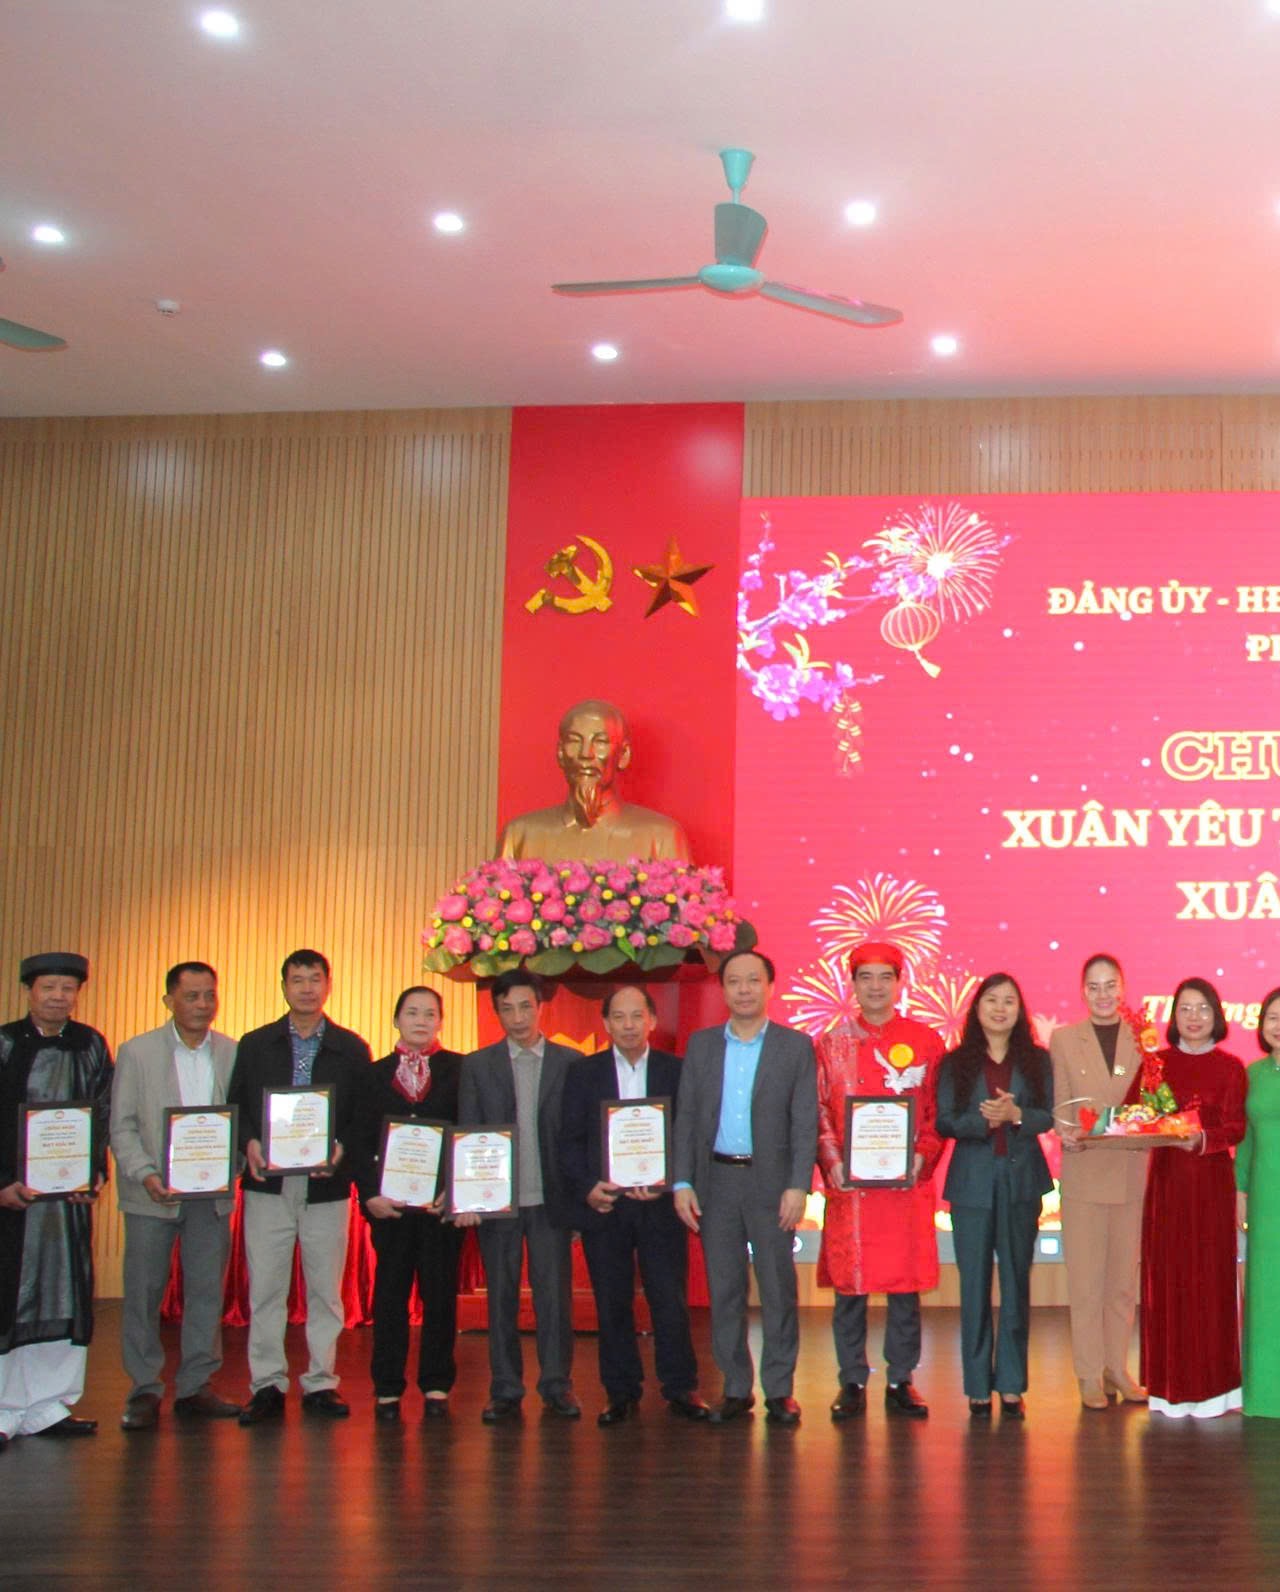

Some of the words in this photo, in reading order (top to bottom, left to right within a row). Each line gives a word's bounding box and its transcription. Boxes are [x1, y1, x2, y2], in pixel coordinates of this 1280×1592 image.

[1047, 580, 1153, 615] ĐẢNG
[1160, 580, 1211, 614] ỦY
[1002, 800, 1152, 848] XUÂN
[1158, 798, 1265, 847] YÊU
